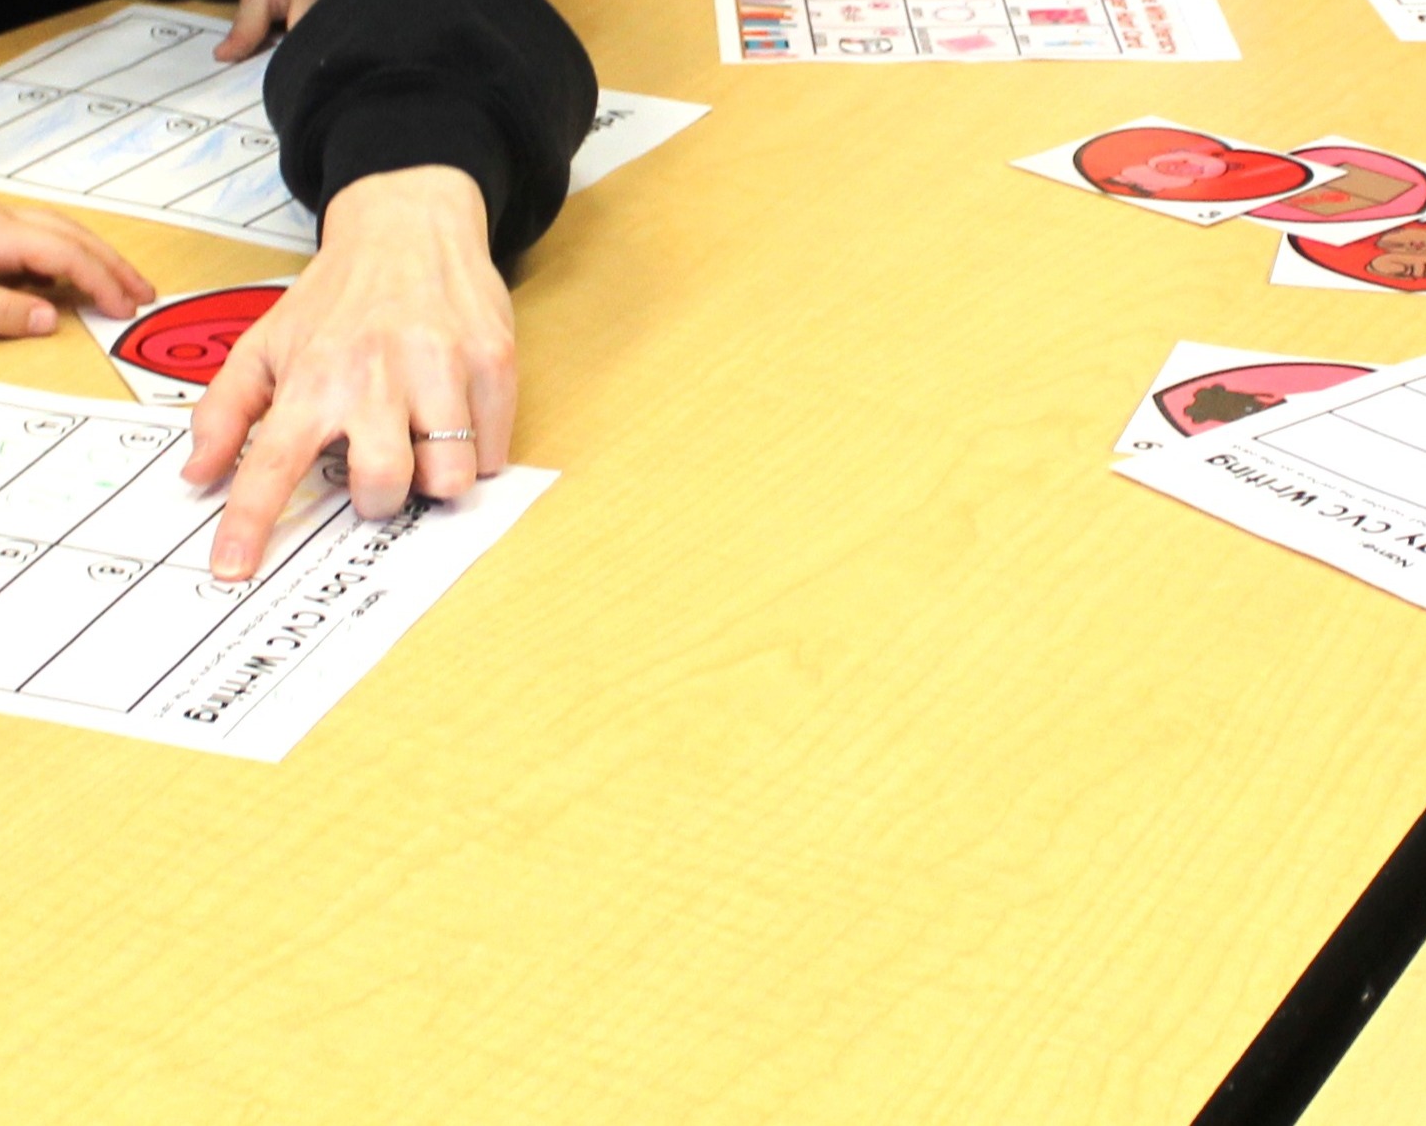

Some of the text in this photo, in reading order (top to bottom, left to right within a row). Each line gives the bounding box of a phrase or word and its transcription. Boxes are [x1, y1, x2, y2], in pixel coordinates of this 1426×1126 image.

[1205, 454, 1318, 507] Writing
[1318, 505, 1391, 533] CVC
[304, 572, 367, 608] Day
[266, 610, 326, 651] CVC
[183, 655, 287, 723] Writing
